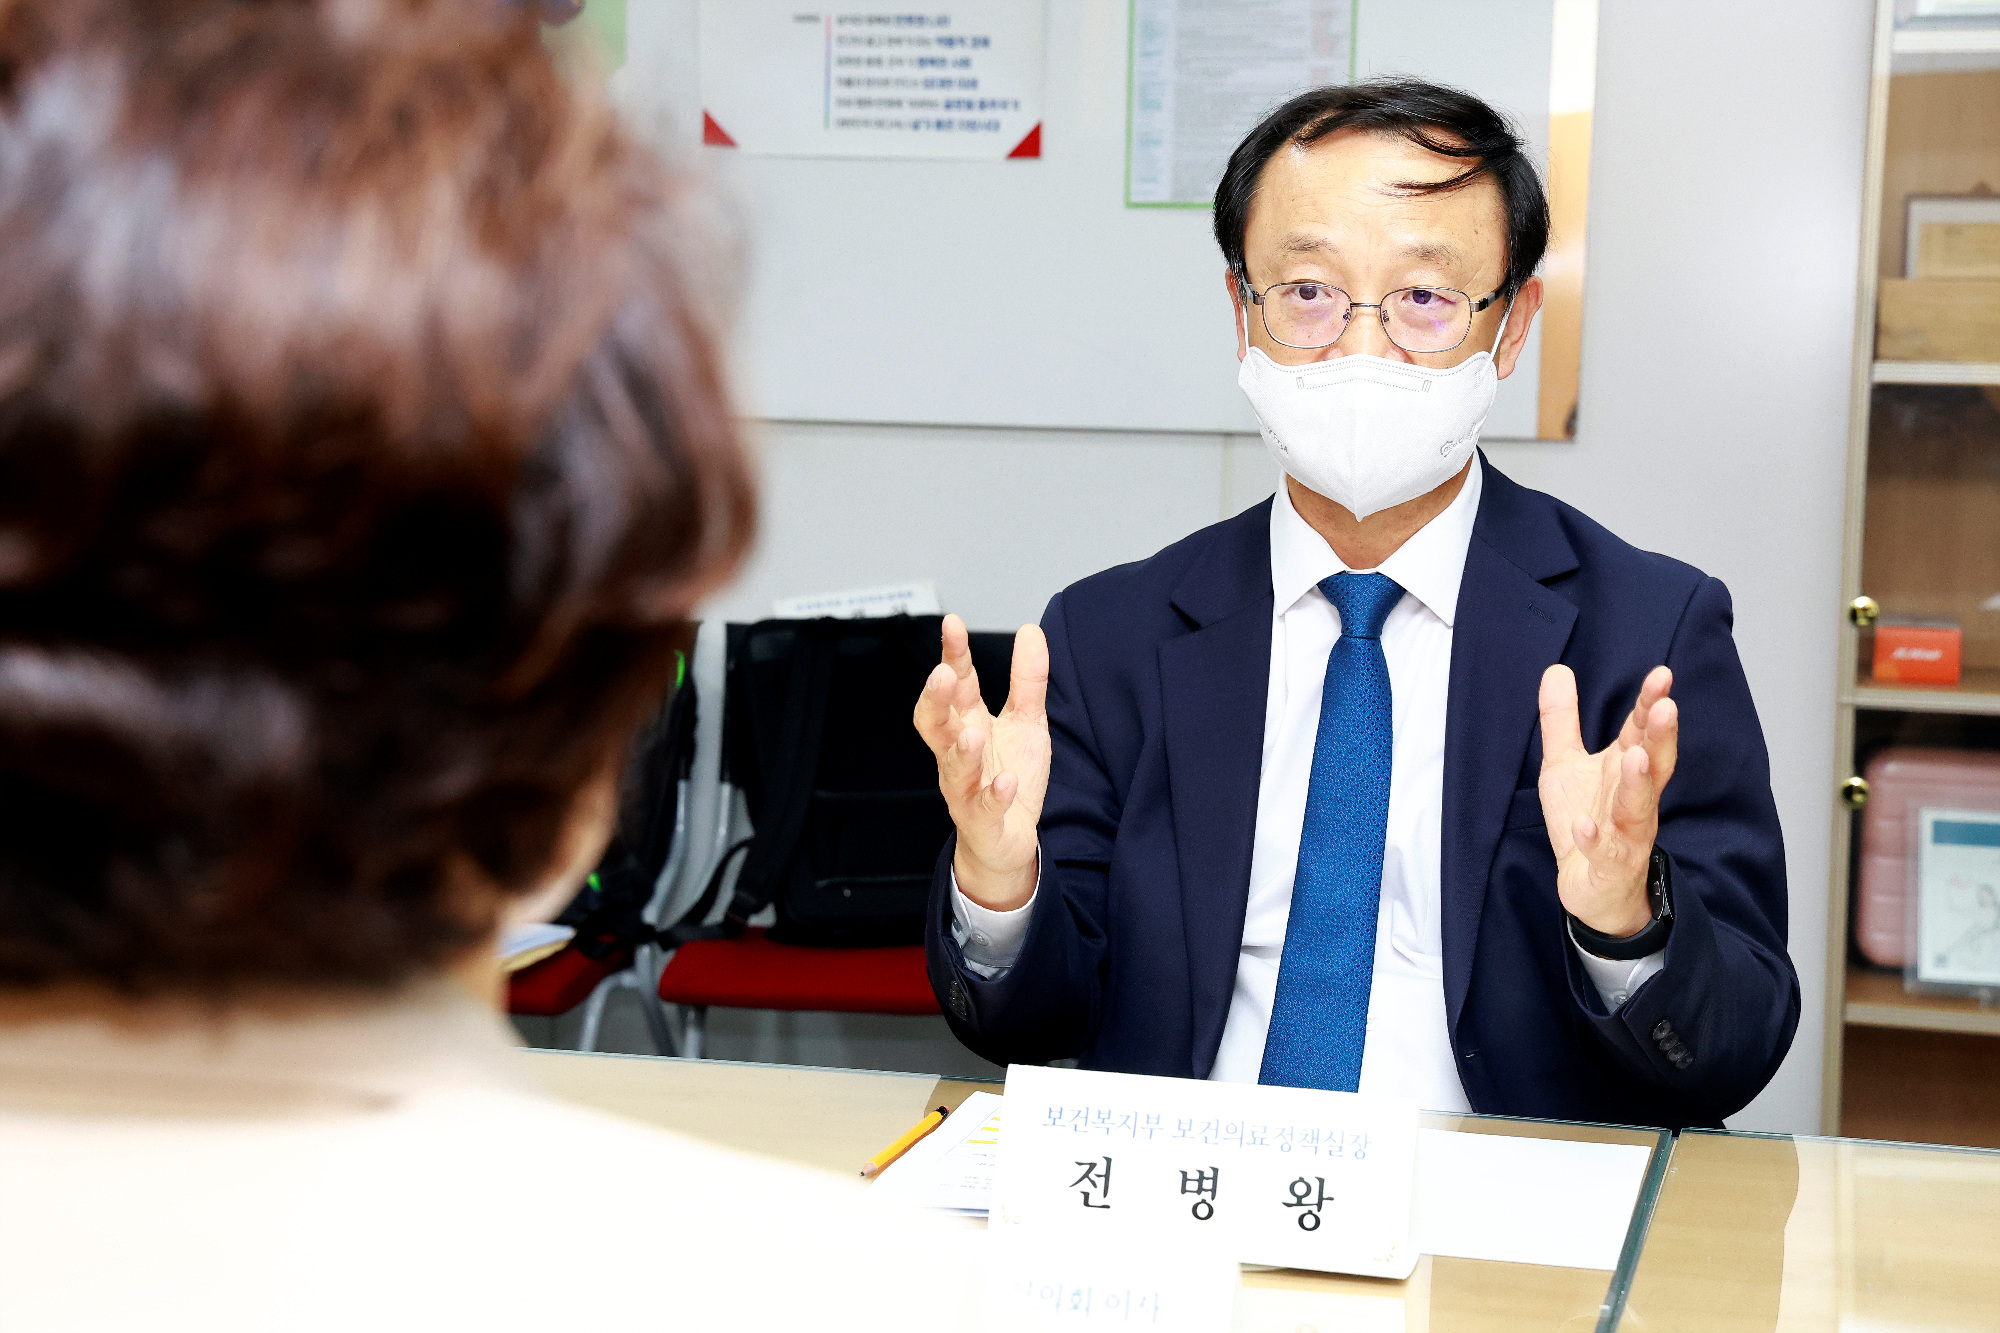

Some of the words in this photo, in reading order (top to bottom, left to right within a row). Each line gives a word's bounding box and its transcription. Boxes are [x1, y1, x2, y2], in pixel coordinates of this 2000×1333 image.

[1043, 1106, 1164, 1141] 보건복지부
[1170, 1118, 1372, 1160] 보건의료정책실장
[1069, 1156, 1112, 1208] 전
[1179, 1166, 1218, 1220] 병
[1282, 1176, 1334, 1231] 왕
[1104, 1288, 1160, 1324] 이사
